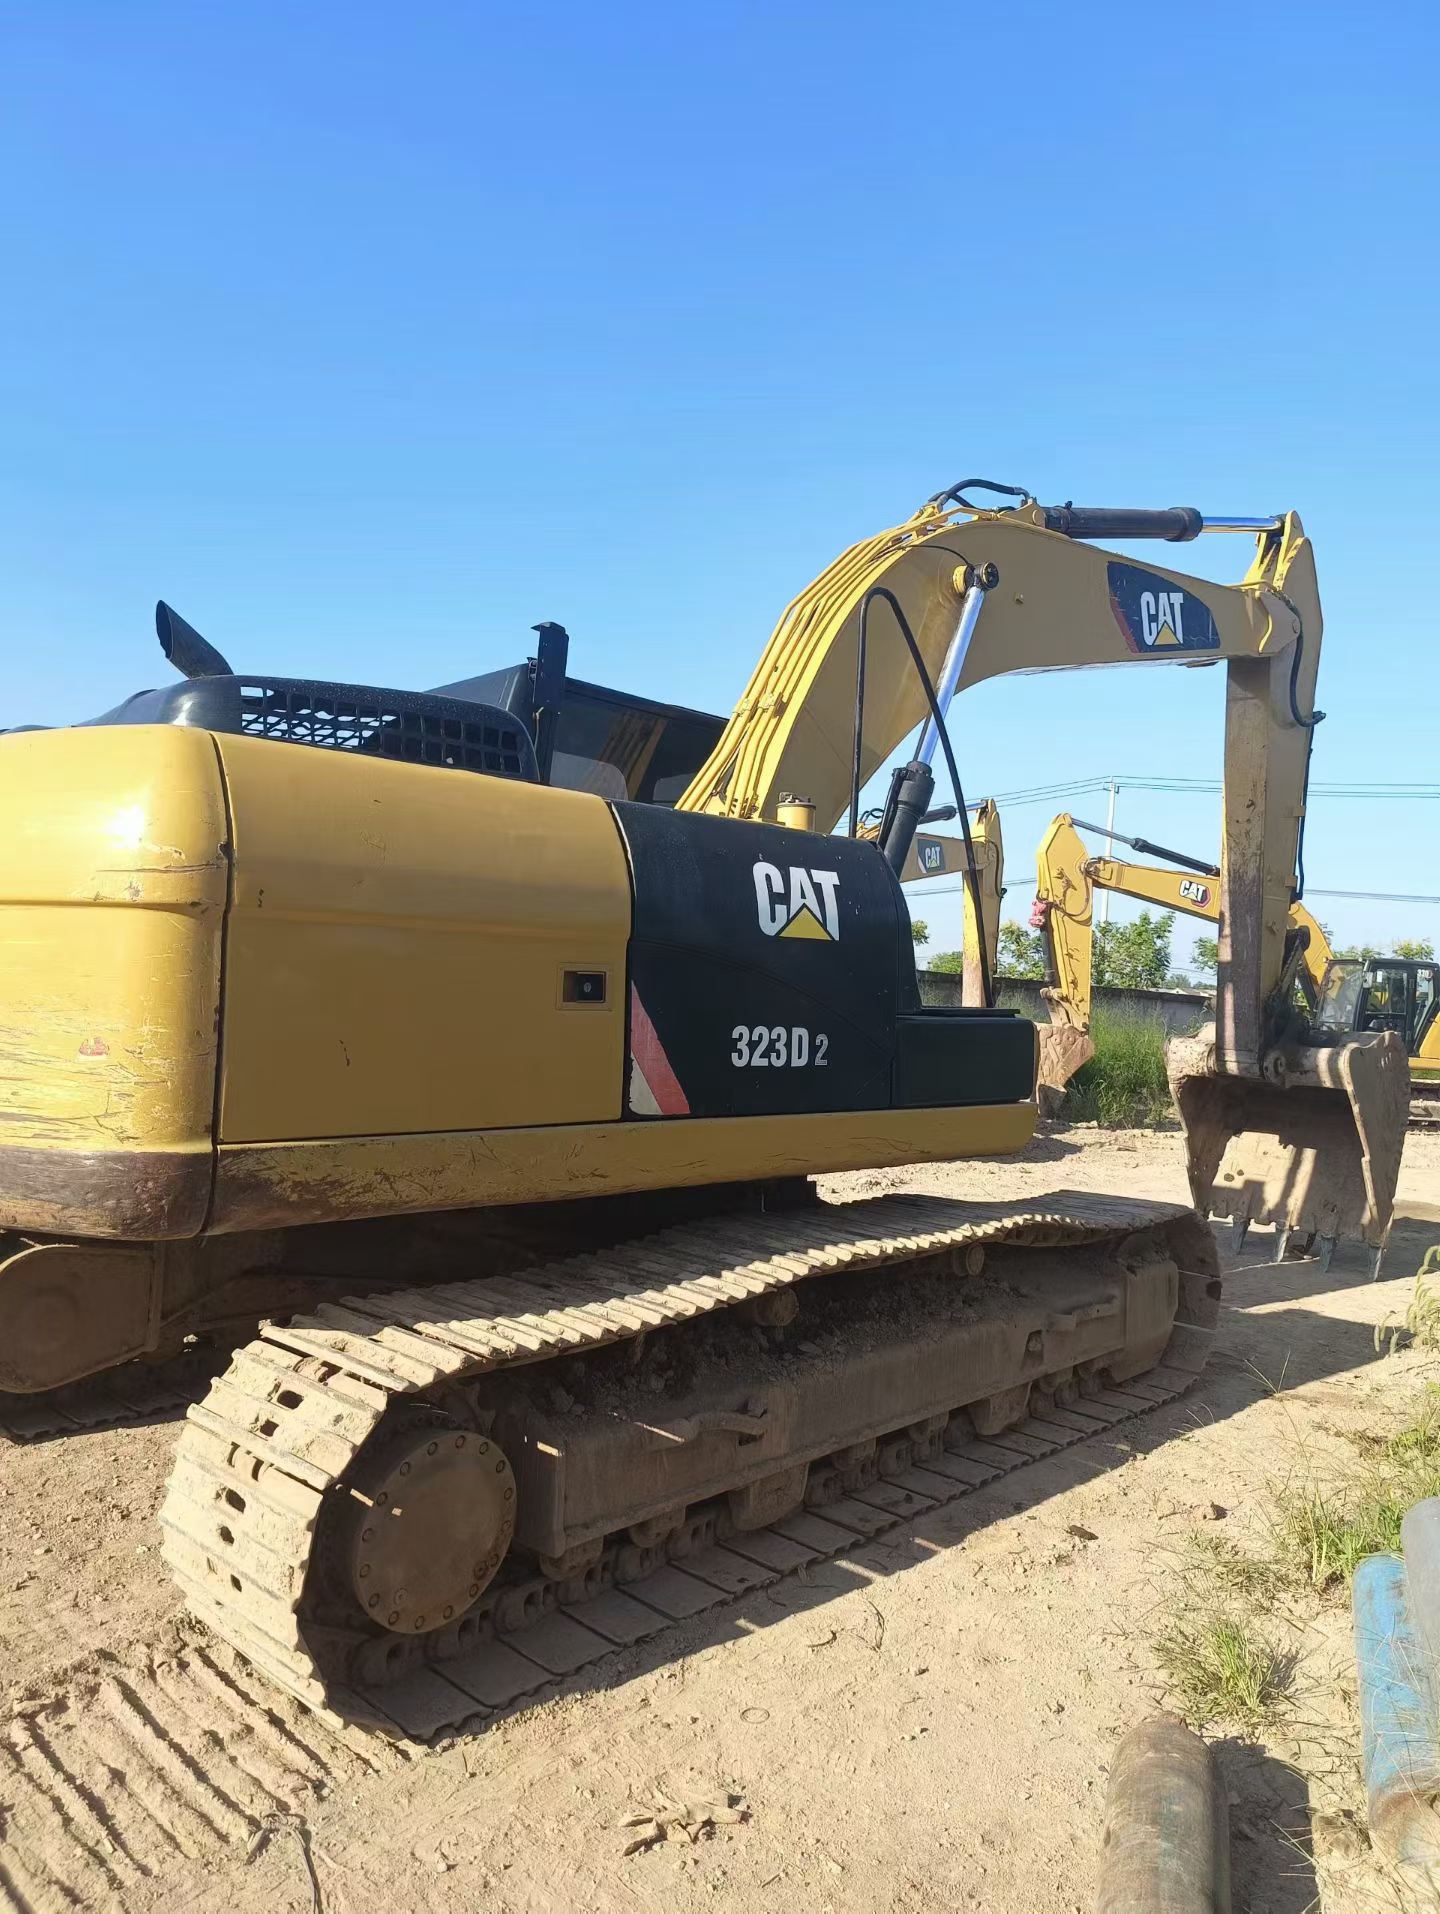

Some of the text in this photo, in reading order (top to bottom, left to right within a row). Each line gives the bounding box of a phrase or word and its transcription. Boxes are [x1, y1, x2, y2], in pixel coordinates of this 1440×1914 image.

[1140, 591, 1184, 646] CAT
[925, 846, 941, 869] CAT
[752, 861, 841, 941] CAT
[1180, 880, 1206, 902] CAT
